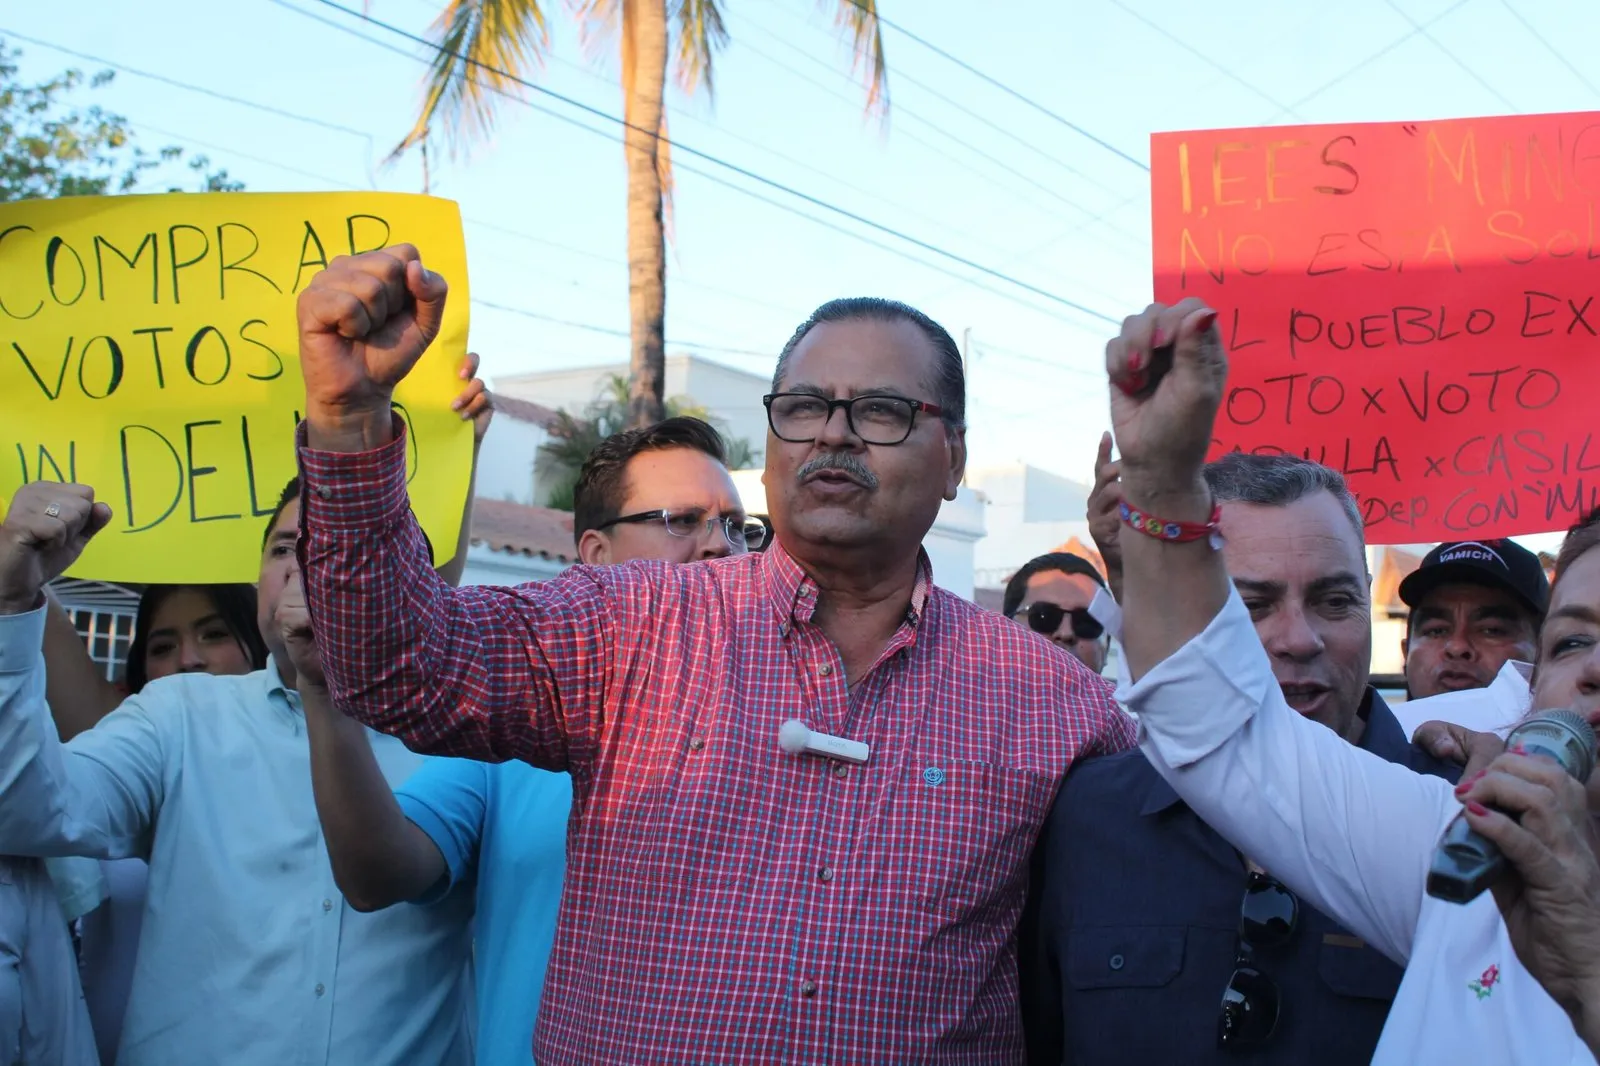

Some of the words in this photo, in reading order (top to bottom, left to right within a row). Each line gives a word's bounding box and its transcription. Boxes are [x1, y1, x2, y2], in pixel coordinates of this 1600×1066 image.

[1180, 227, 1274, 290] NO
[1289, 305, 1495, 361] PUEBLO
[1520, 290, 1598, 338] EX
[12, 319, 283, 400] VOTOS
[1226, 374, 1345, 425] OTO
[1398, 366, 1561, 422] VOTO
[1439, 549, 1494, 564] VAMICH
